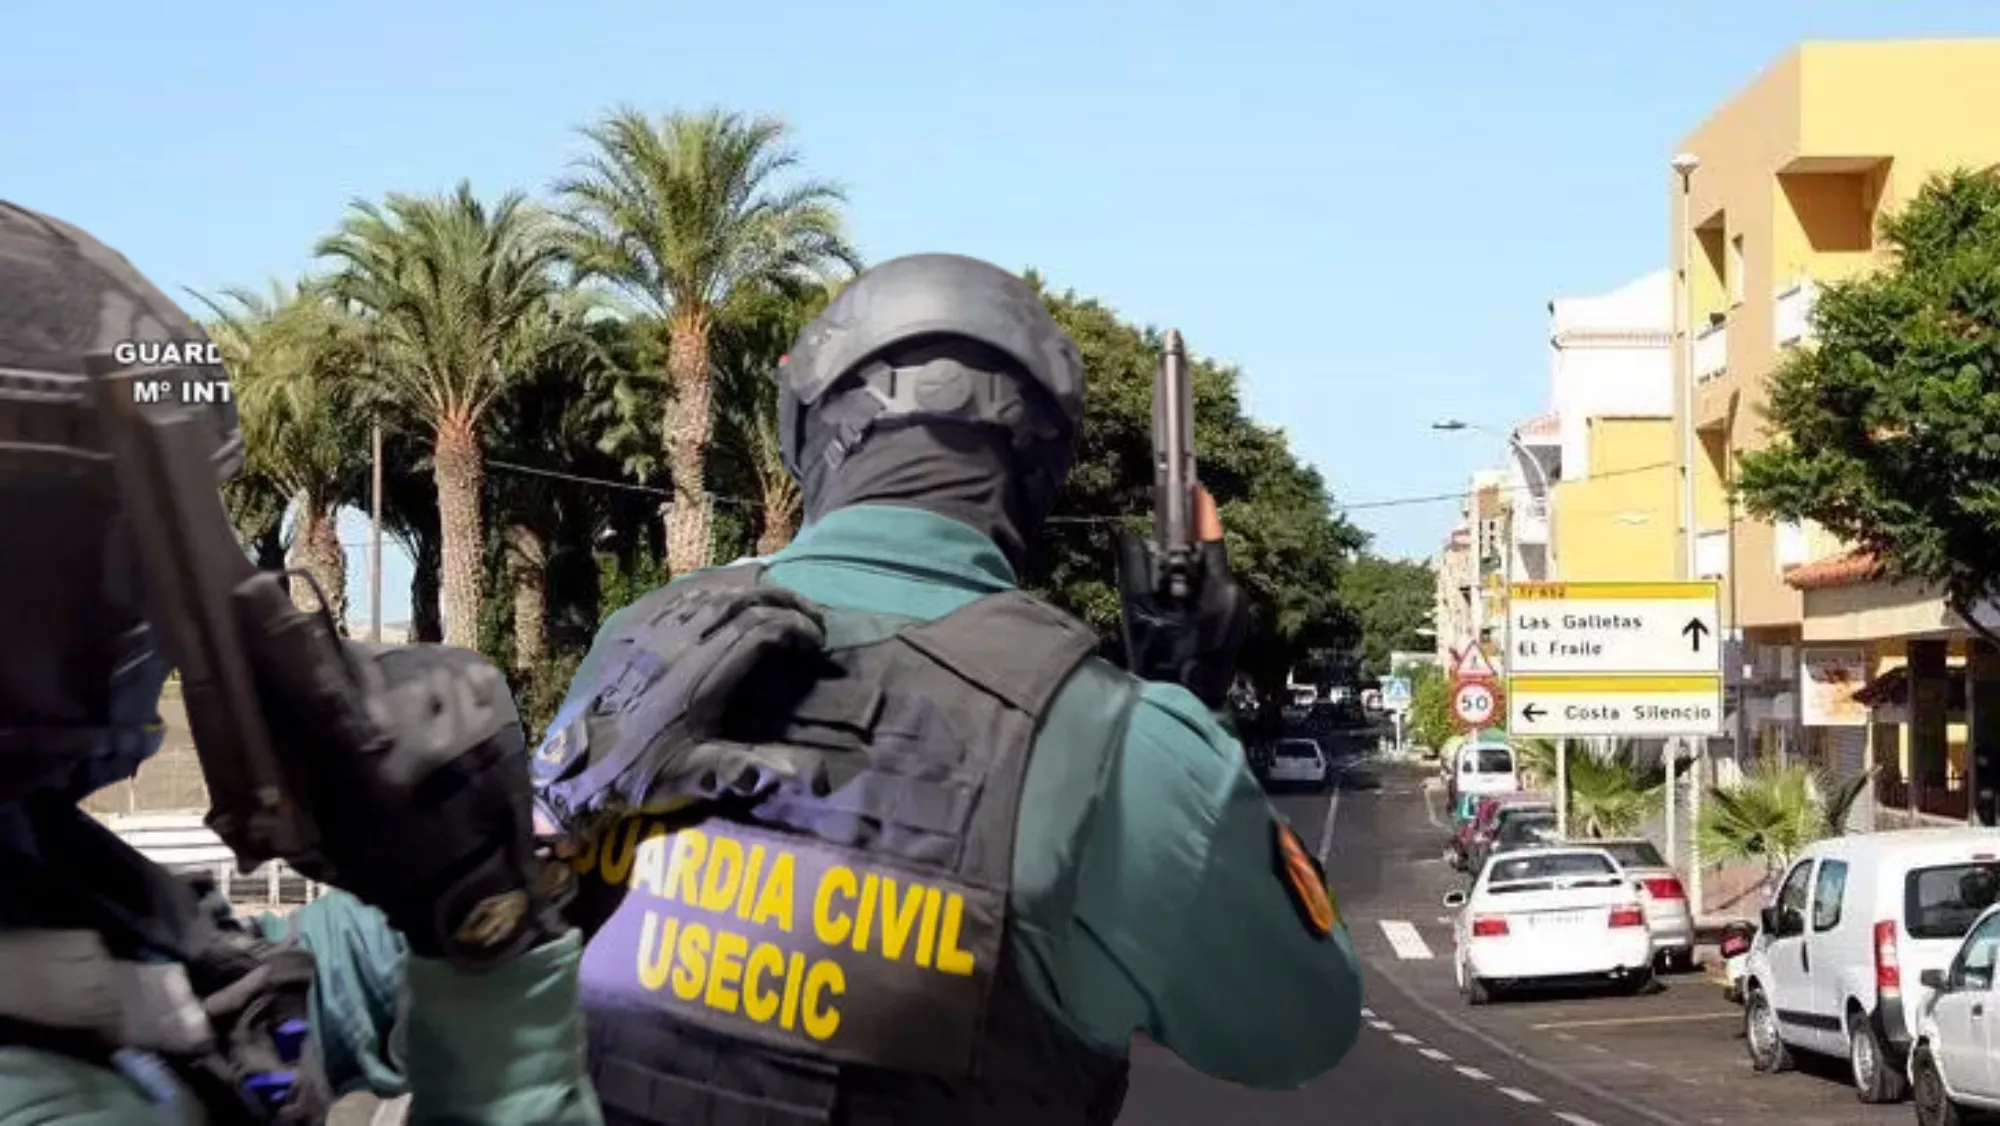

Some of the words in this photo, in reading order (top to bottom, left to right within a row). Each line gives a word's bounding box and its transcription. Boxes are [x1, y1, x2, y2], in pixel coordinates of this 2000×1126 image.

[1518, 614, 1551, 630] Las
[1562, 614, 1643, 630] Galletas
[1518, 641, 1537, 657] El
[1462, 693, 1489, 711] 50
[1563, 704, 1621, 721] Costa
[1632, 704, 1711, 721] Silencio
[812, 865, 975, 976] CIVIL
[636, 911, 847, 1042] USECIC
